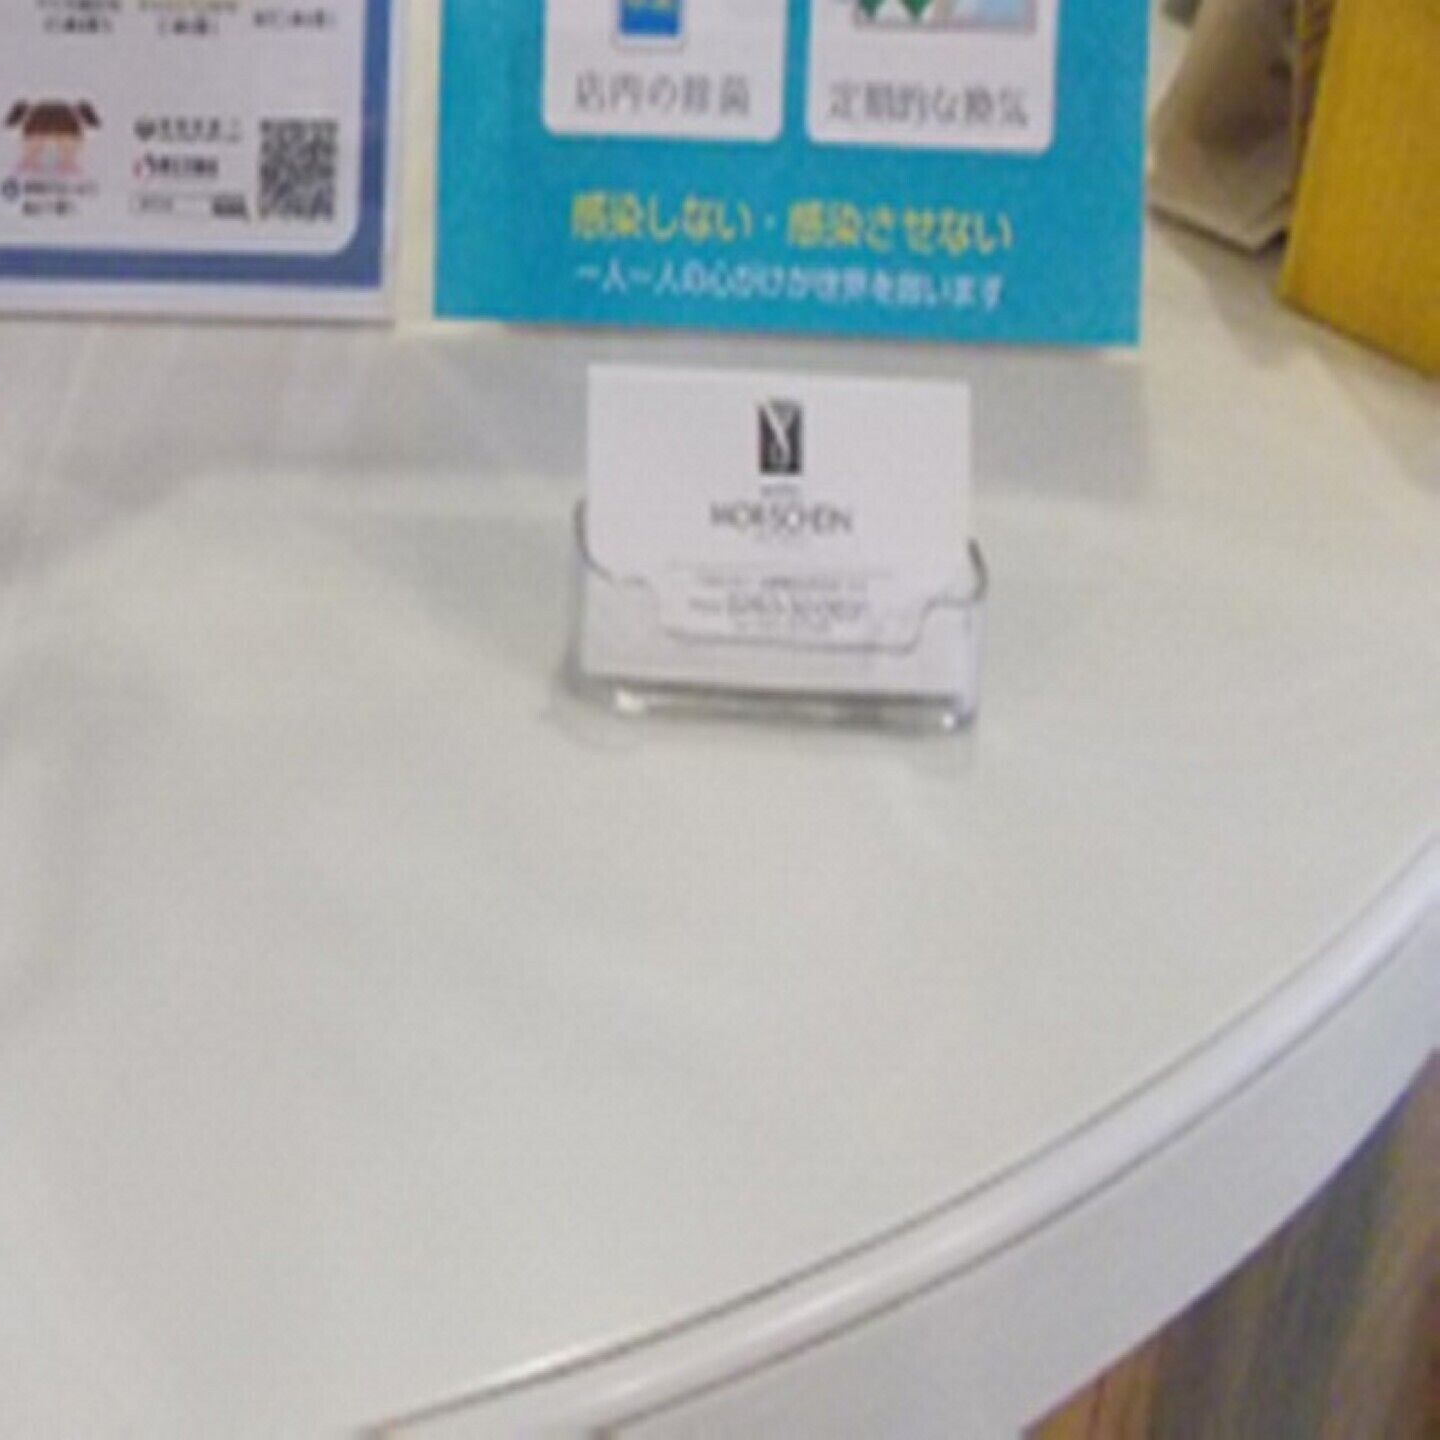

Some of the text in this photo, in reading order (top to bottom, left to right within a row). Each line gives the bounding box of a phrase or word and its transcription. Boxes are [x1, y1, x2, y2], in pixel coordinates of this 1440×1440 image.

[574, 72, 750, 116] 店内の除菌
[828, 82, 1028, 130] 定期的な換気
[571, 192, 1013, 255] 感染しない・感染させない
